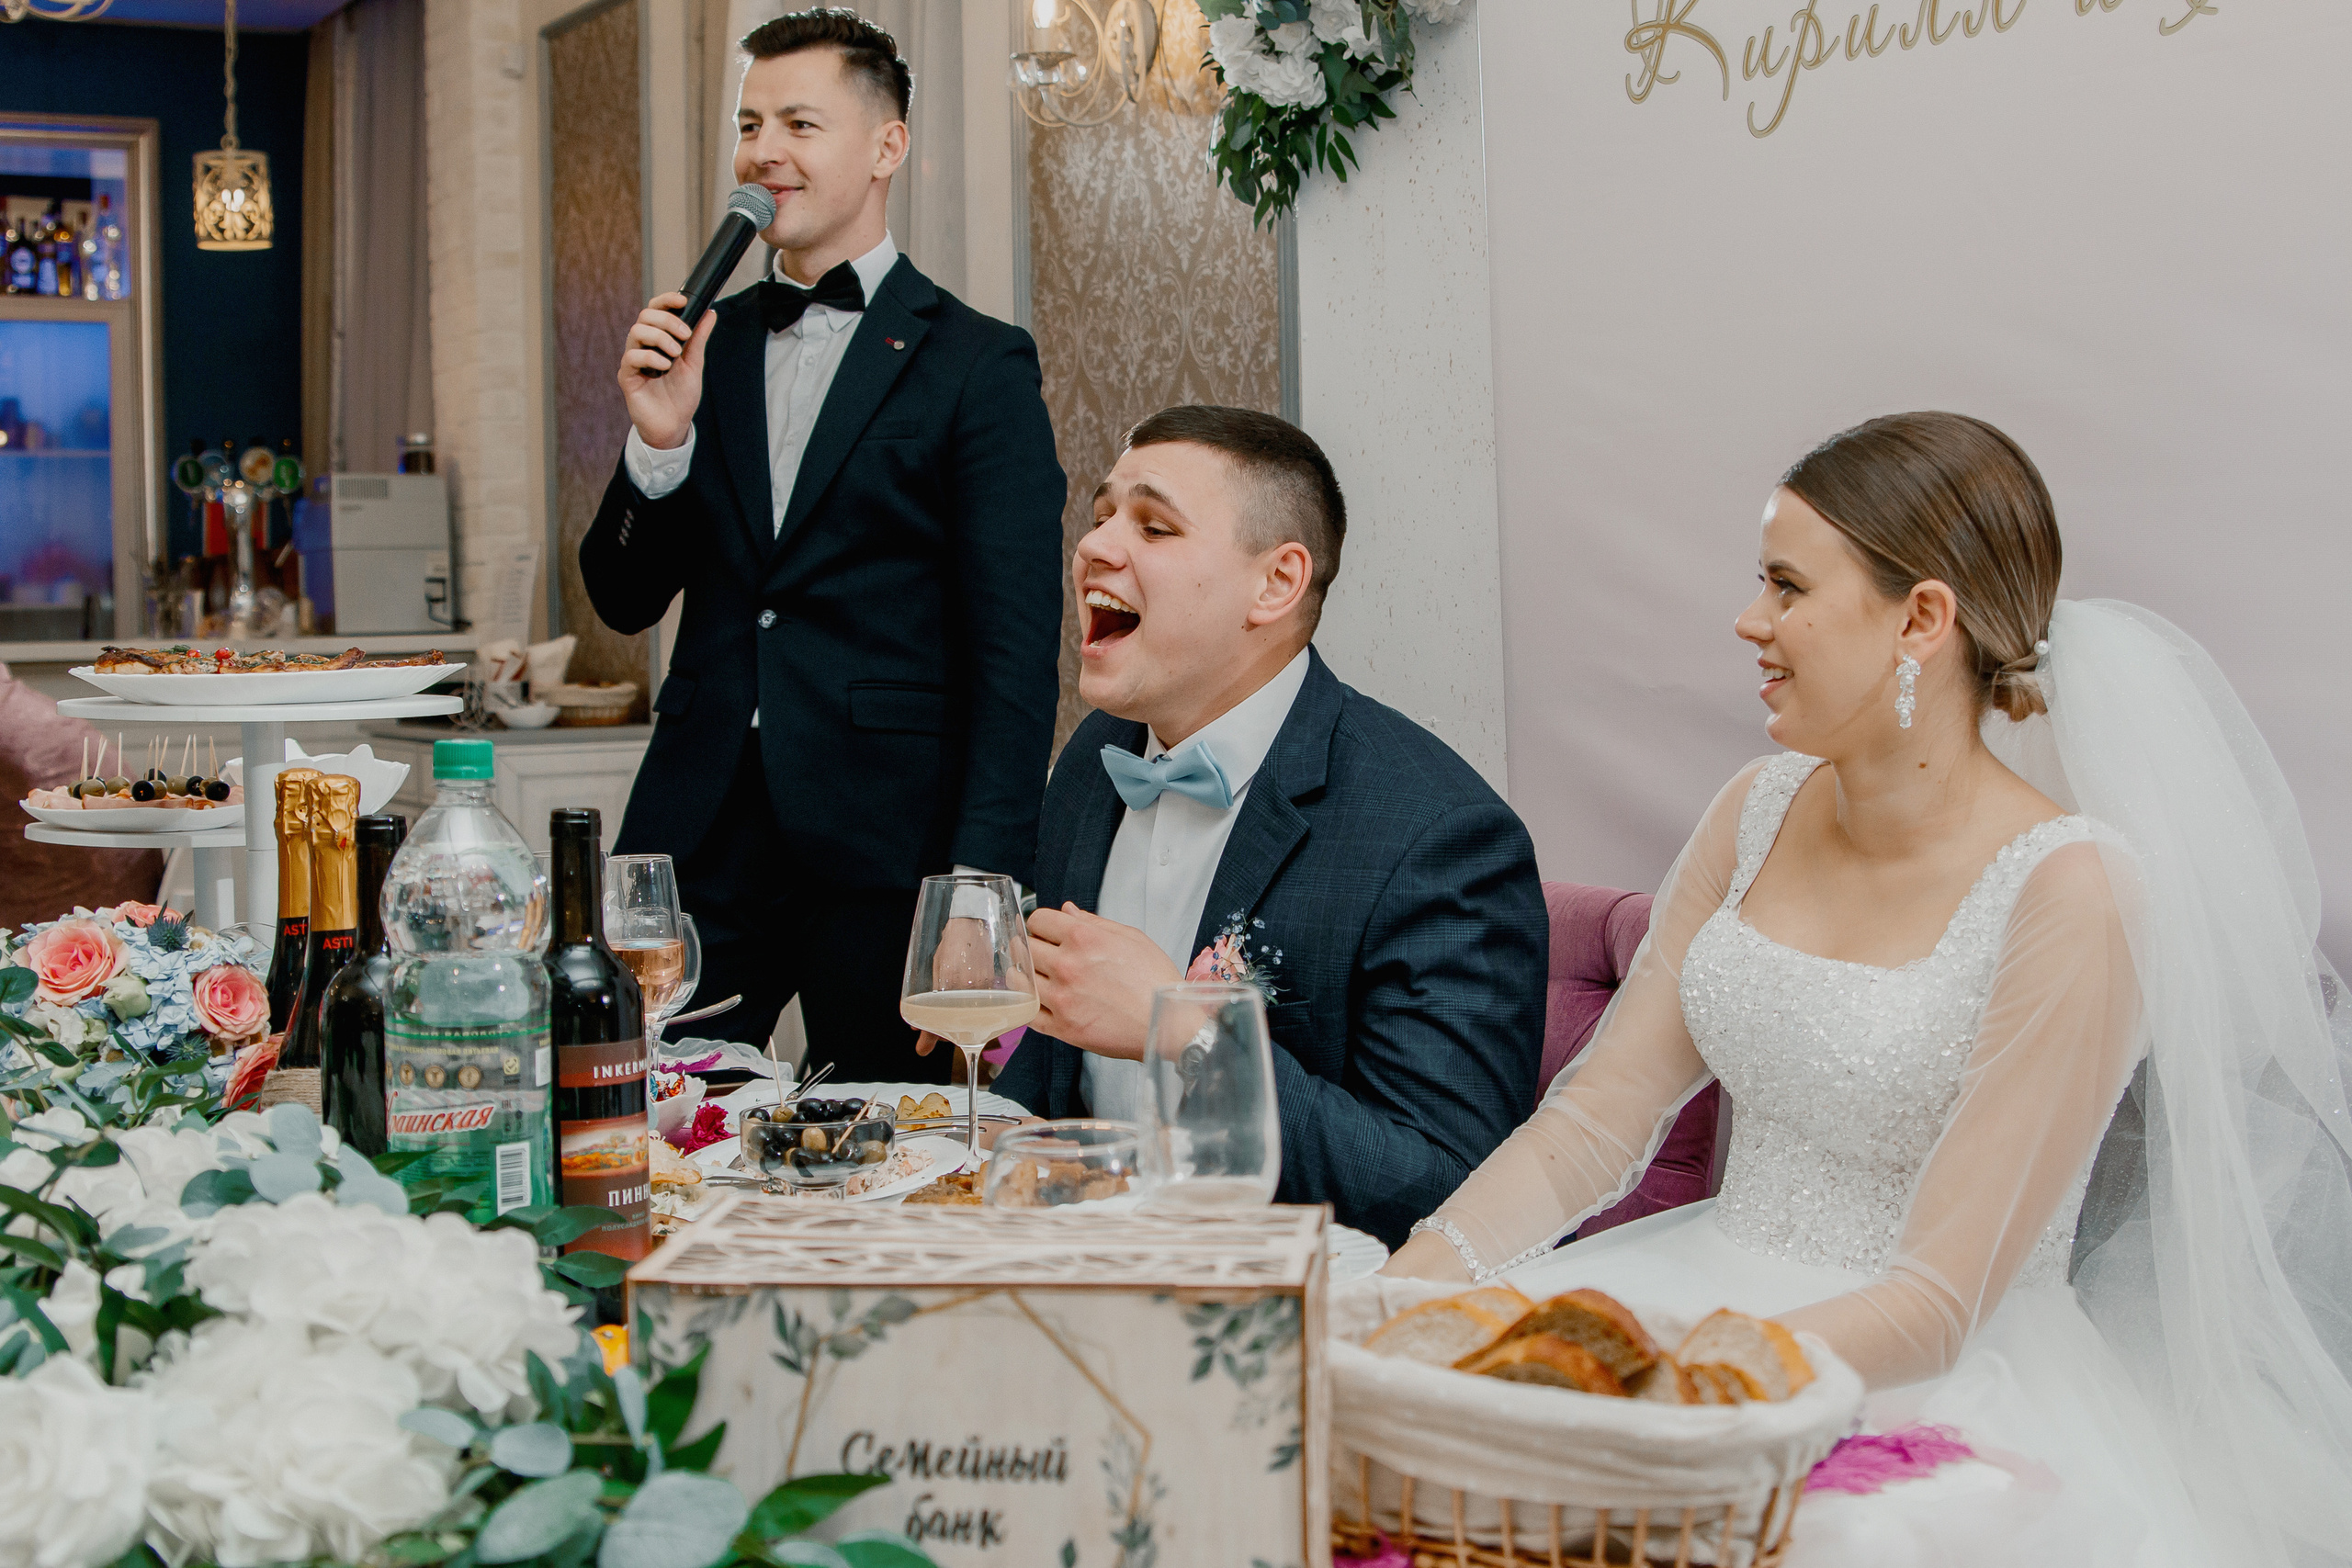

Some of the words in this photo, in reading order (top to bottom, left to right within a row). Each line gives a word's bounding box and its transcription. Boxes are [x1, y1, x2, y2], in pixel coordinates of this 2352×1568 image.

[1624, 0, 2027, 139] Кирилл
[283, 923, 308, 937] AST
[322, 935, 354, 951] ASTI
[841, 1429, 1069, 1485] Семейный
[904, 1492, 1006, 1551] банк
